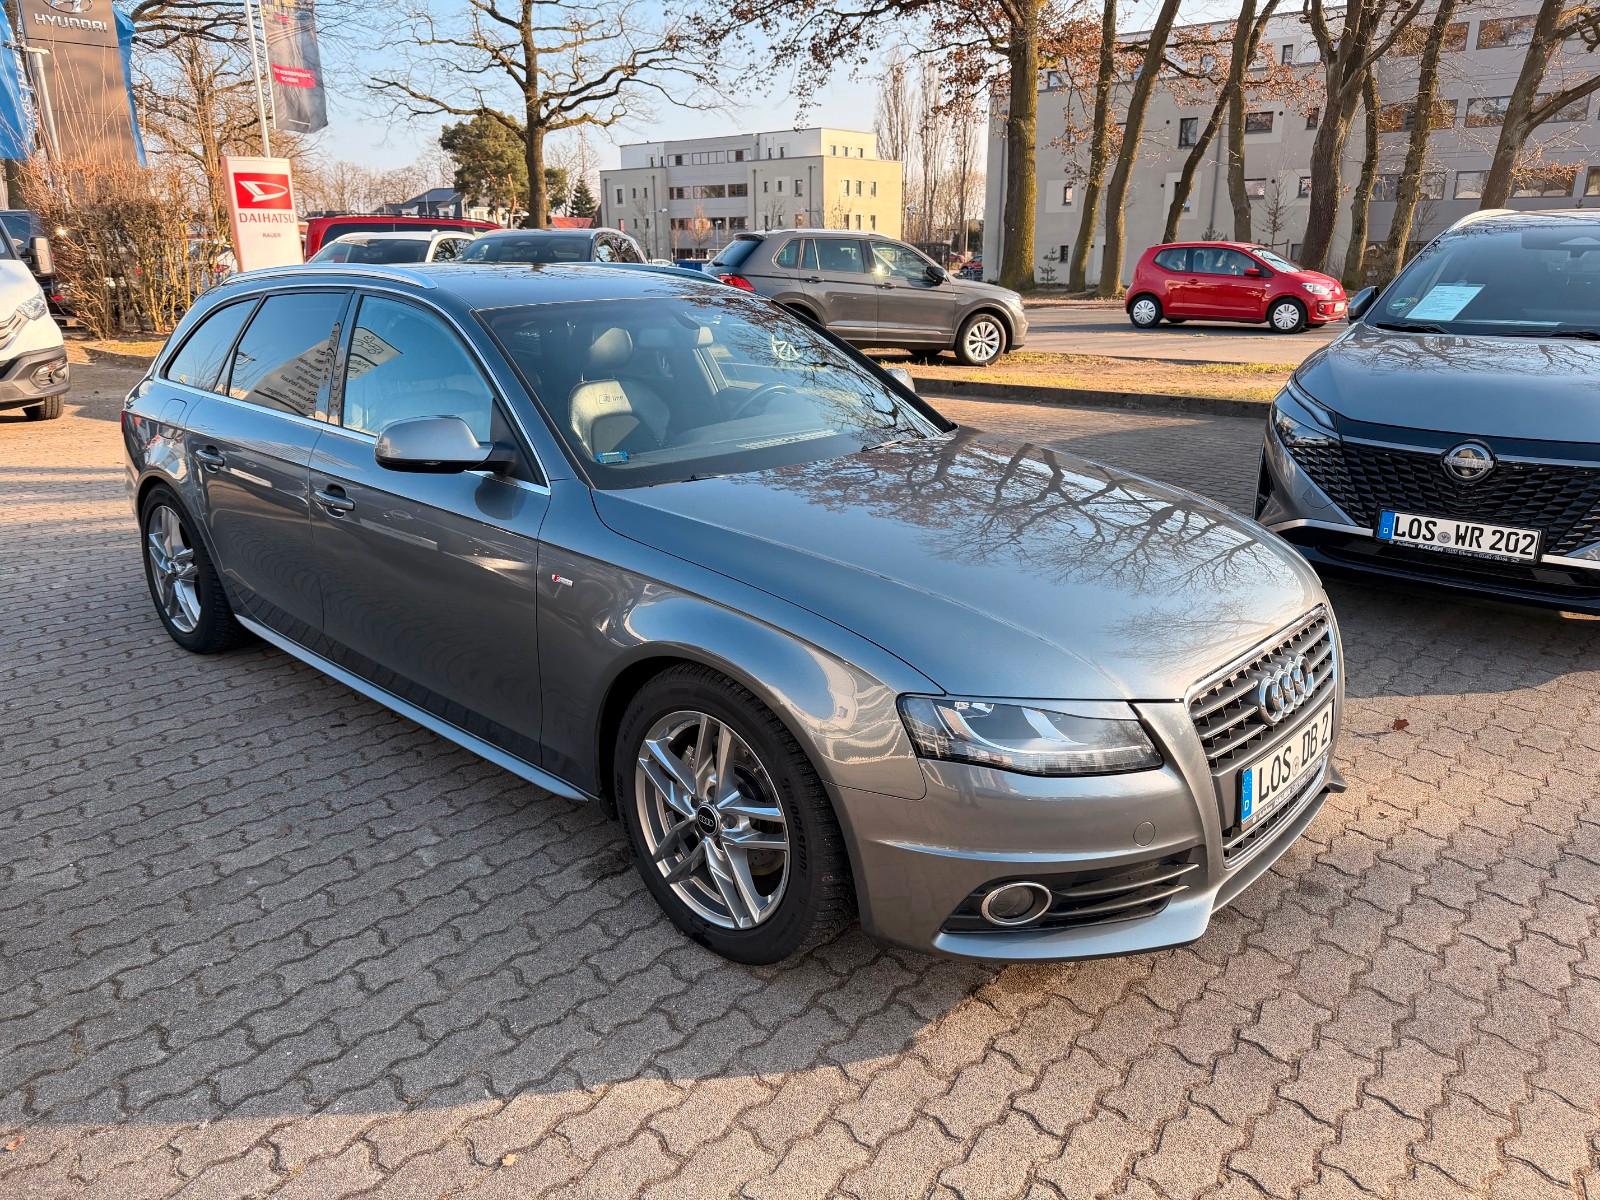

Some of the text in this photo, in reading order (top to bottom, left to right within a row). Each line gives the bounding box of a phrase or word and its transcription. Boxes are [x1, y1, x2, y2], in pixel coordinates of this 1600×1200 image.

[34, 13, 108, 32] HYUNDAI
[239, 212, 295, 223] DAIHATSU
[1393, 515, 1438, 541] LOS
[1454, 524, 1484, 549] WR
[1489, 529, 1536, 555] 202
[1244, 799, 1249, 811] D
[1258, 745, 1292, 803] LOS
[1301, 722, 1318, 767] DB
[1321, 711, 1329, 747] 2
